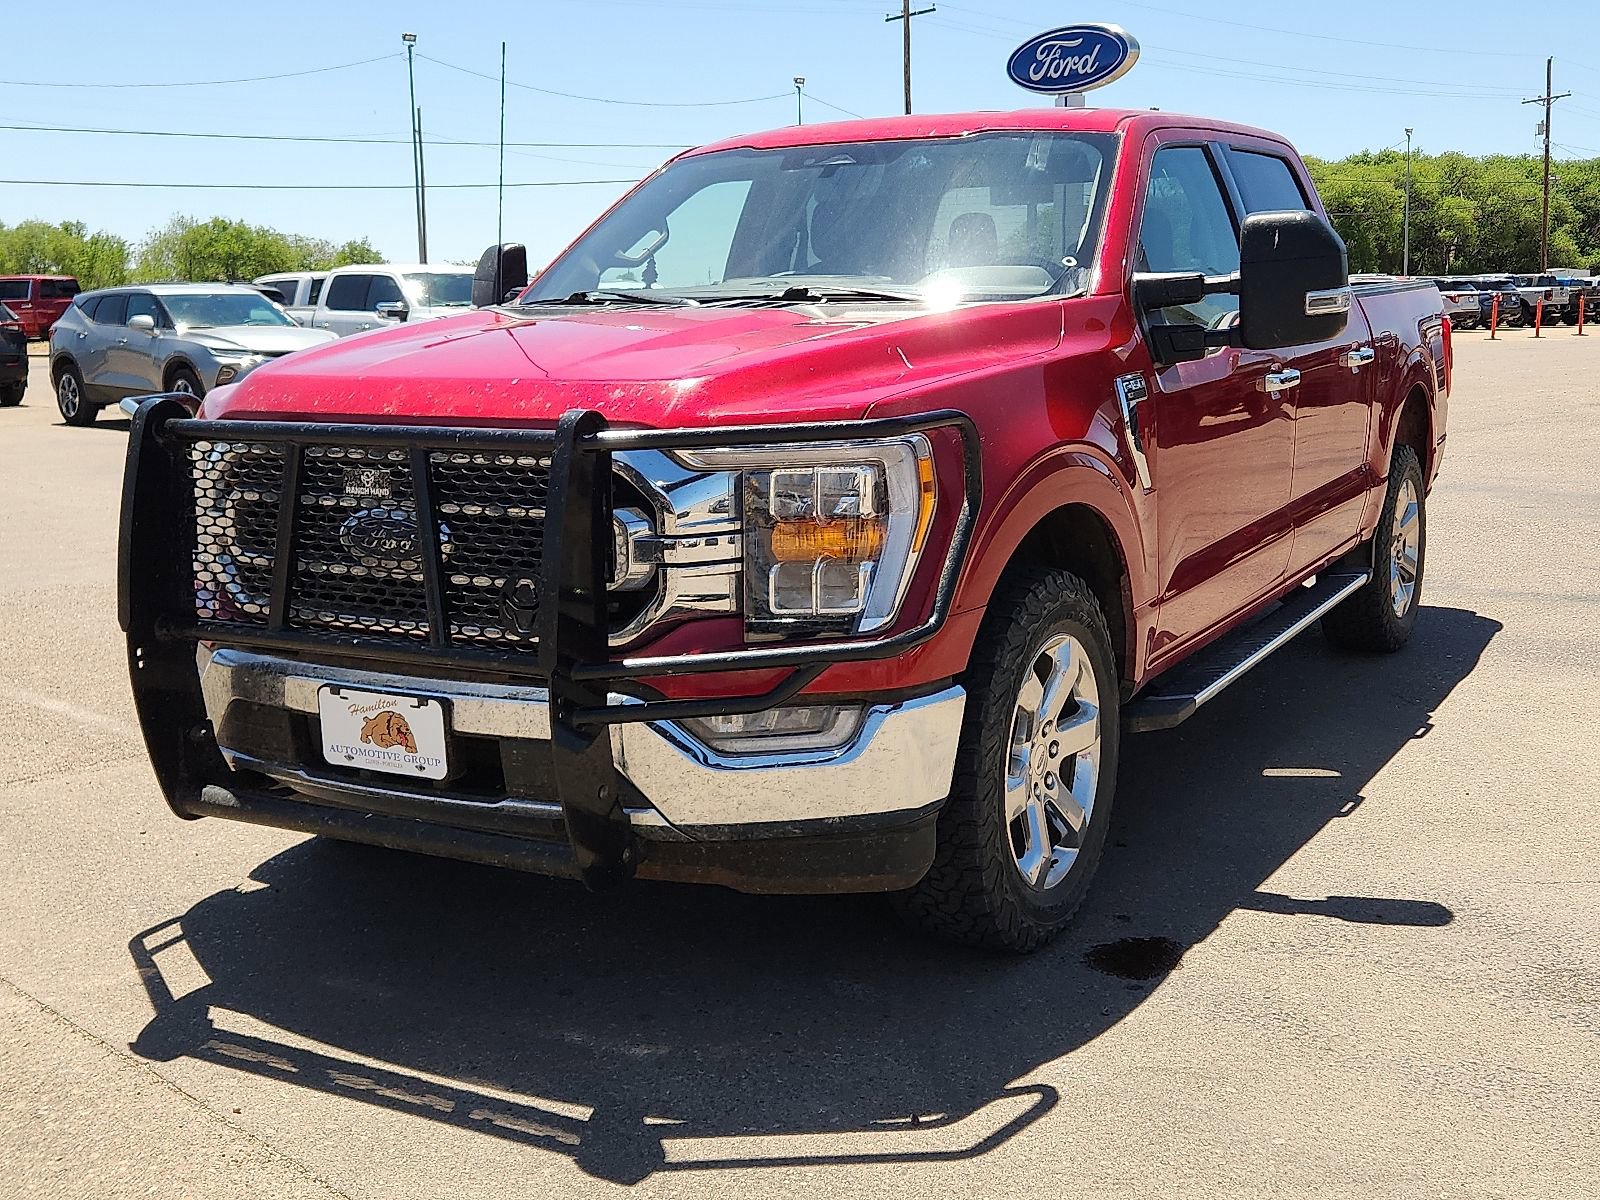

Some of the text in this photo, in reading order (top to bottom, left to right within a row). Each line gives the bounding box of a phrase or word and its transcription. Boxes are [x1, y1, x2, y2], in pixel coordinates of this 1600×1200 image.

[1029, 38, 1102, 81] Ford
[345, 486, 390, 496] RANCH HAND
[347, 698, 399, 717] Hamilton
[329, 744, 401, 762] AUTOMOTIVE
[403, 754, 441, 767] GROUP
